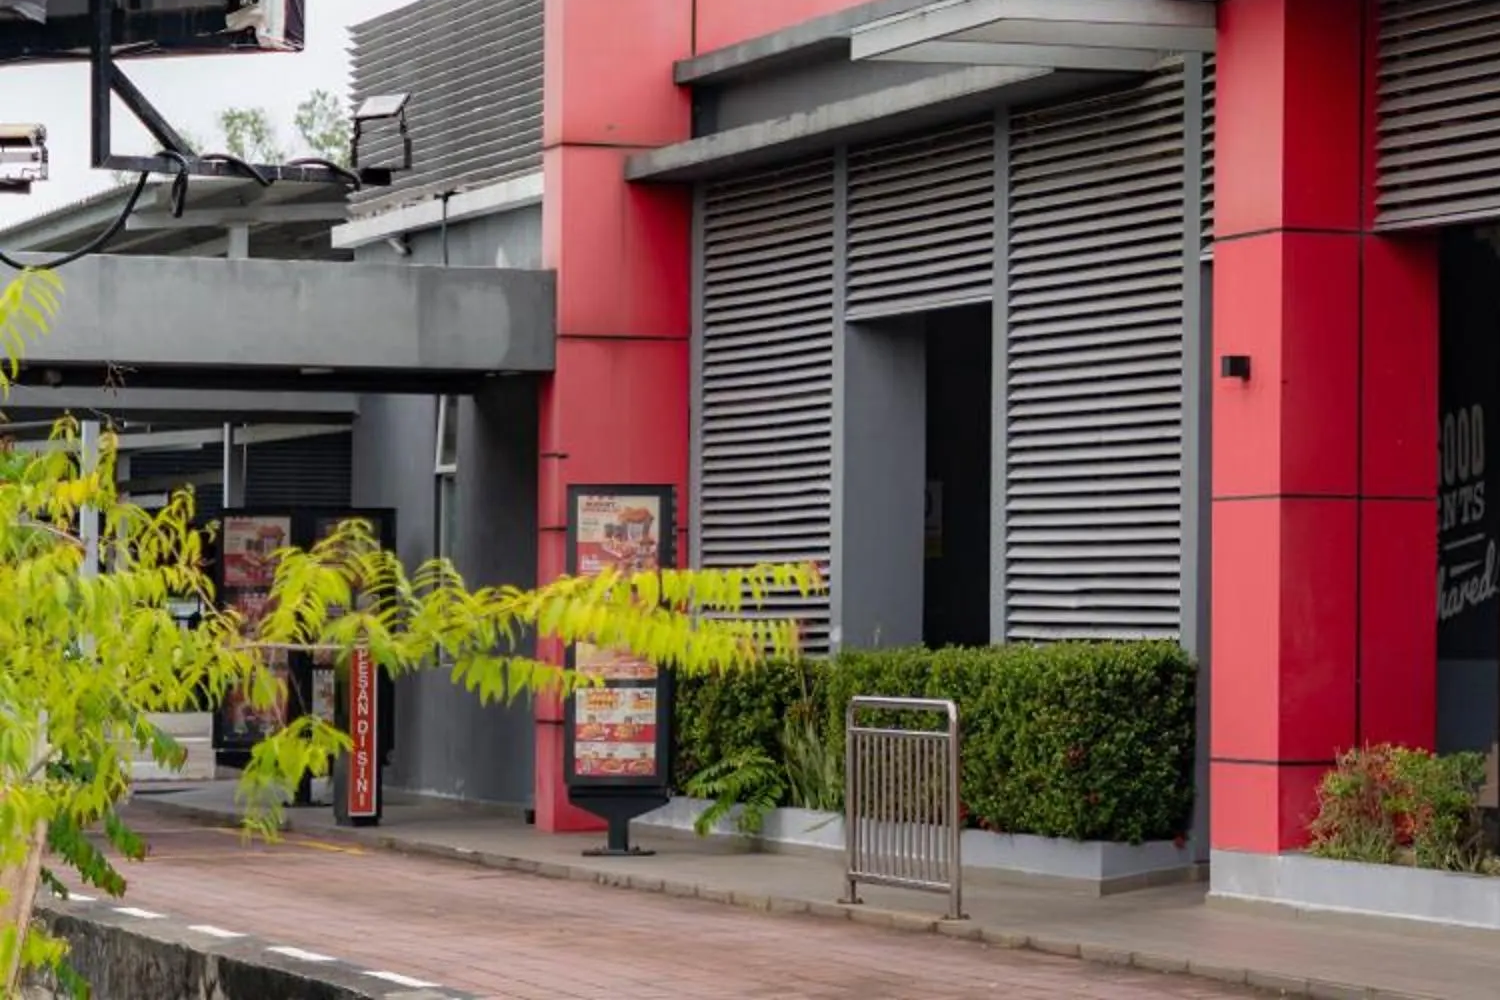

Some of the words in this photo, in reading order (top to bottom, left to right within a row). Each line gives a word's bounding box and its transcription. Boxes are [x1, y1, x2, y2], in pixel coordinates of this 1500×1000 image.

[1438, 403, 1485, 487] OOD
[357, 648, 369, 715] PESAN
[357, 720, 369, 747] DI
